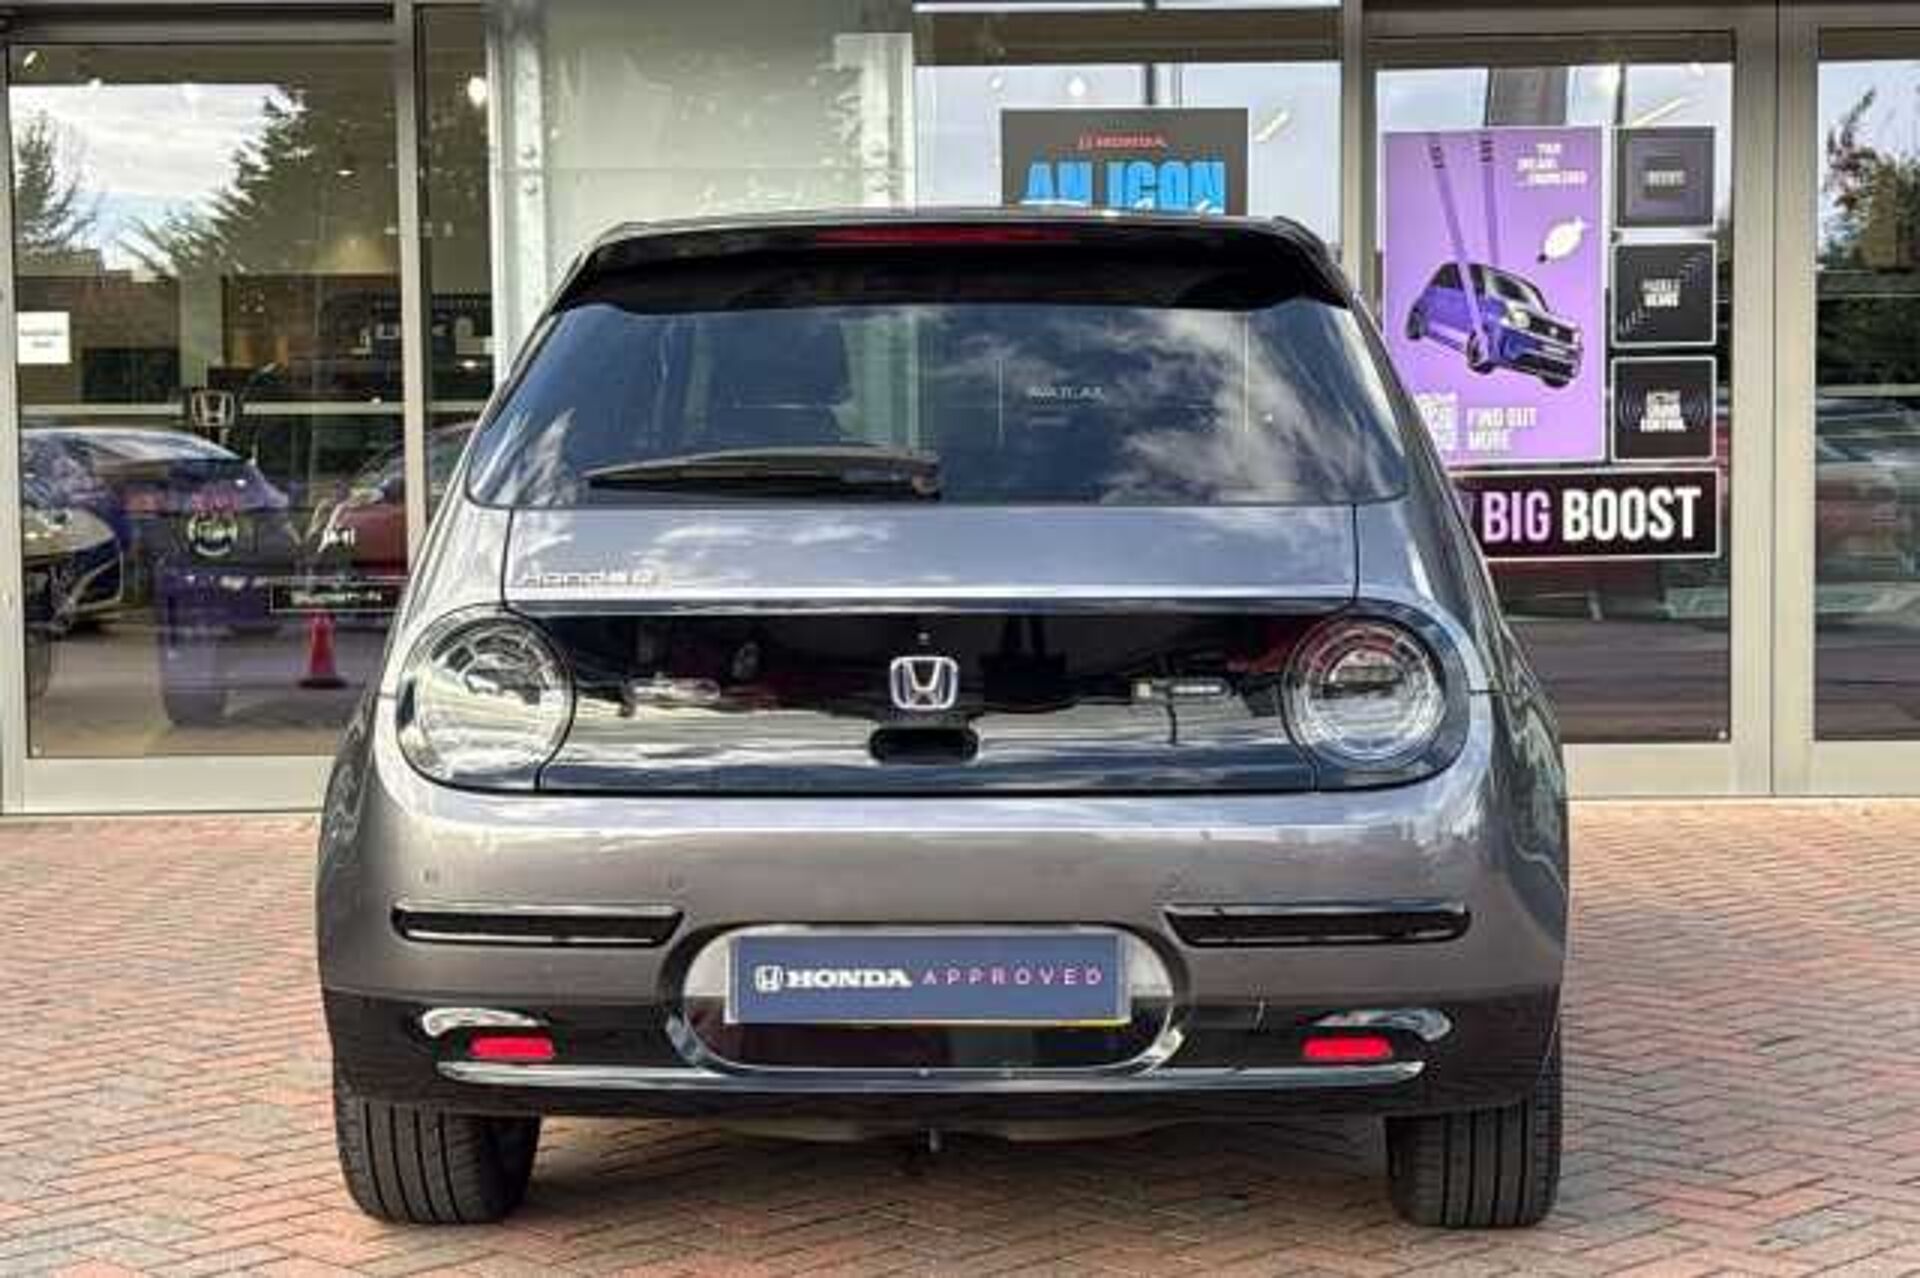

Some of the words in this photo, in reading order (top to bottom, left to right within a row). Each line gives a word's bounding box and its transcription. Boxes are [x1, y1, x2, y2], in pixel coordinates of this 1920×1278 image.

[1106, 160, 1225, 213] ICON
[1483, 490, 1550, 542] BIG
[1562, 487, 1702, 541] BOOST
[785, 968, 912, 989] HONDA
[922, 969, 1102, 986] APPROVED
